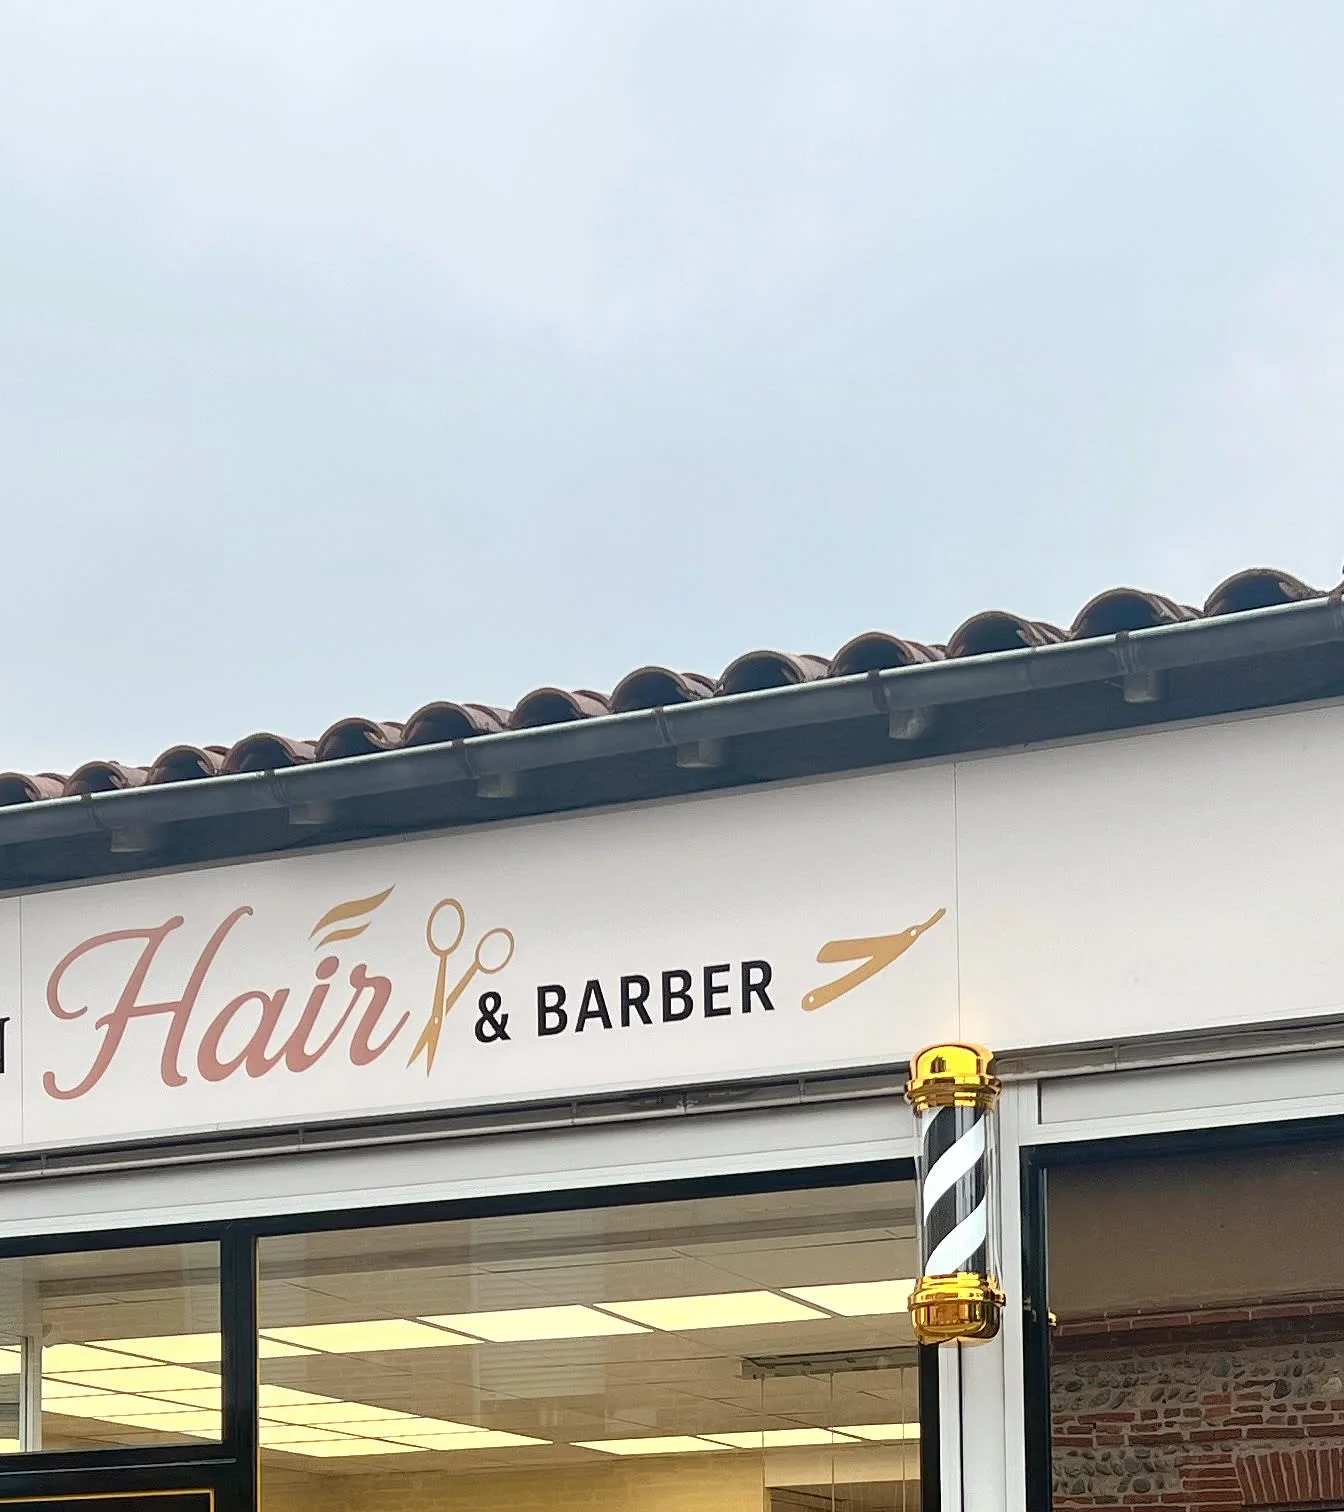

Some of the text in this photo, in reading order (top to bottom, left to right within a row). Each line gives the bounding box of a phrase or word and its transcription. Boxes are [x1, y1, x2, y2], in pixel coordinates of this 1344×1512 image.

[42, 905, 410, 1101] Hair
[473, 989, 513, 1042] &
[536, 958, 776, 1036] BARBER
